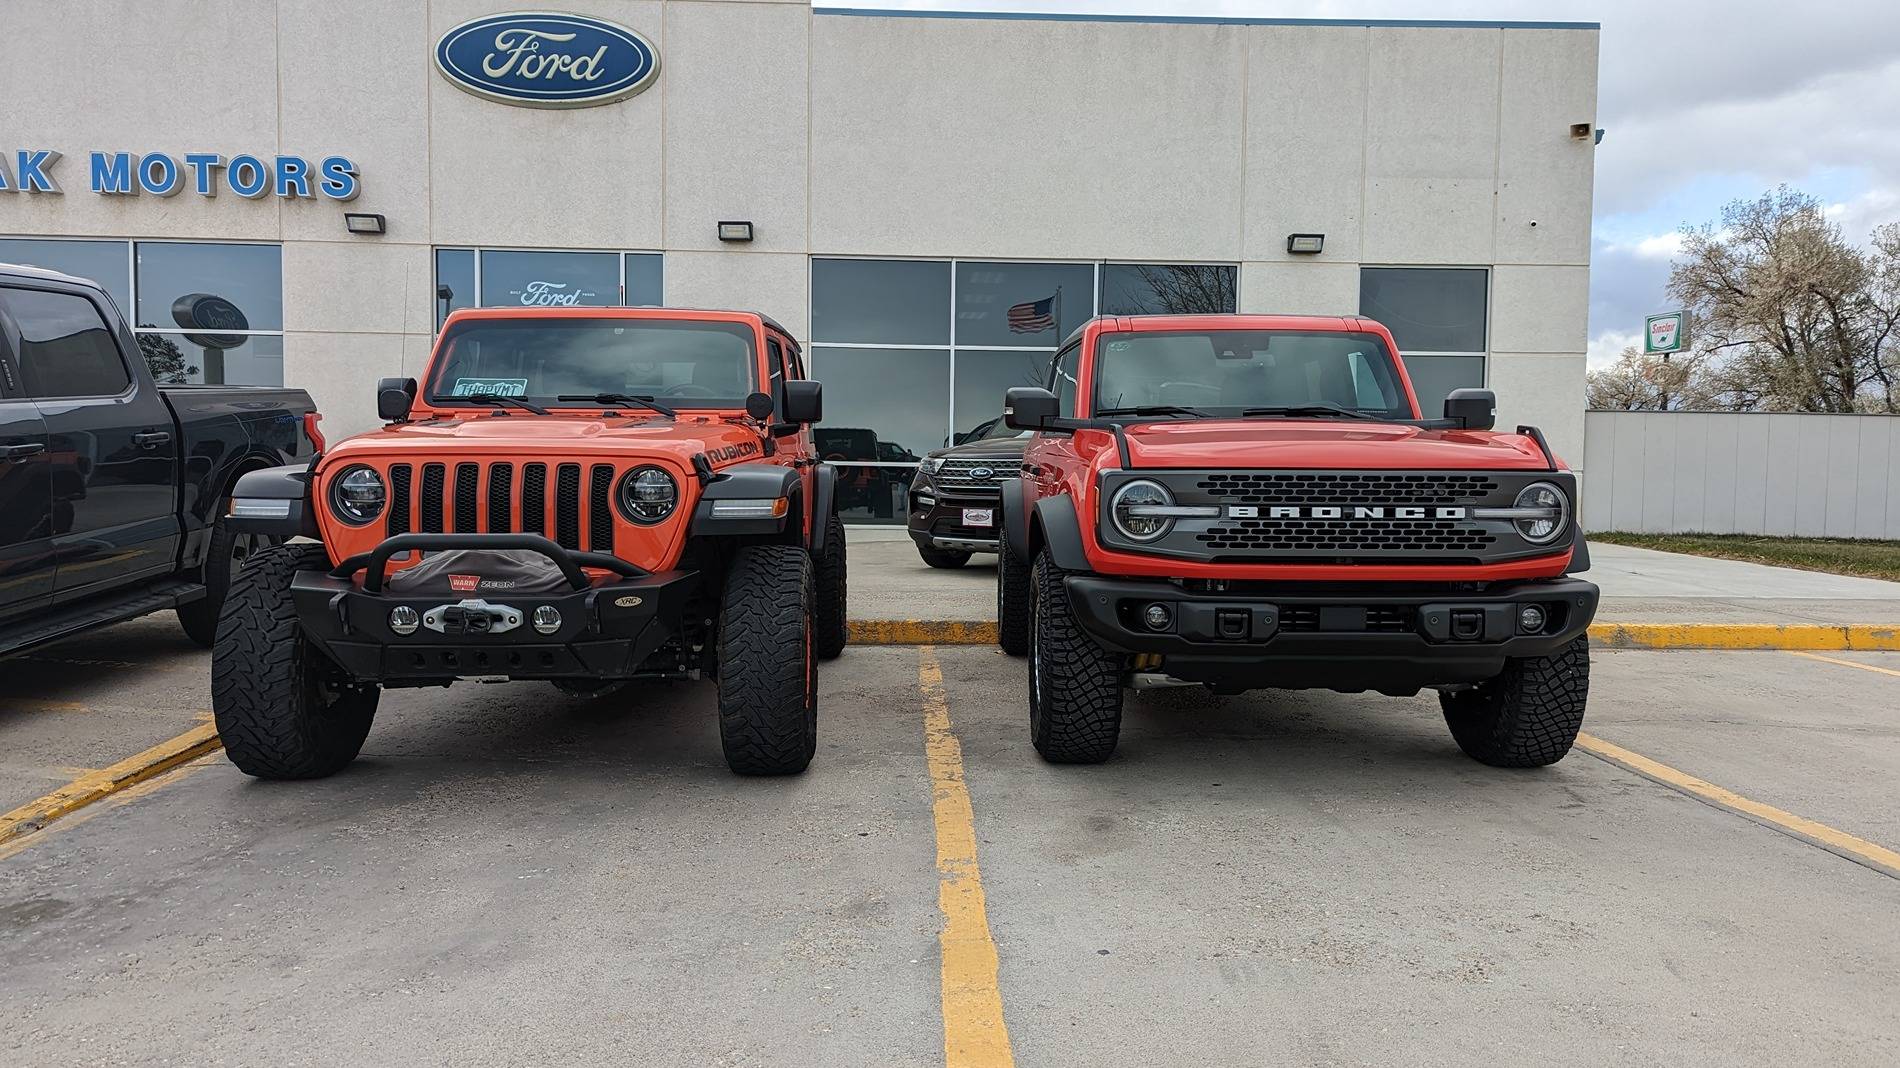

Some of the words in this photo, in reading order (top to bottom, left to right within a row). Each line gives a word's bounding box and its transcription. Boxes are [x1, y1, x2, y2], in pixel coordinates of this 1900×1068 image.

[482, 28, 608, 81] Ford
[89, 150, 362, 201] MOTORS
[520, 281, 581, 306] Ford
[1652, 322, 1676, 335] Sinclair
[706, 441, 759, 464] RUBICON
[1228, 506, 1466, 519] BRONCO
[453, 579, 475, 587] WARN
[480, 580, 515, 589] ZEON
[620, 597, 638, 606] XRC
